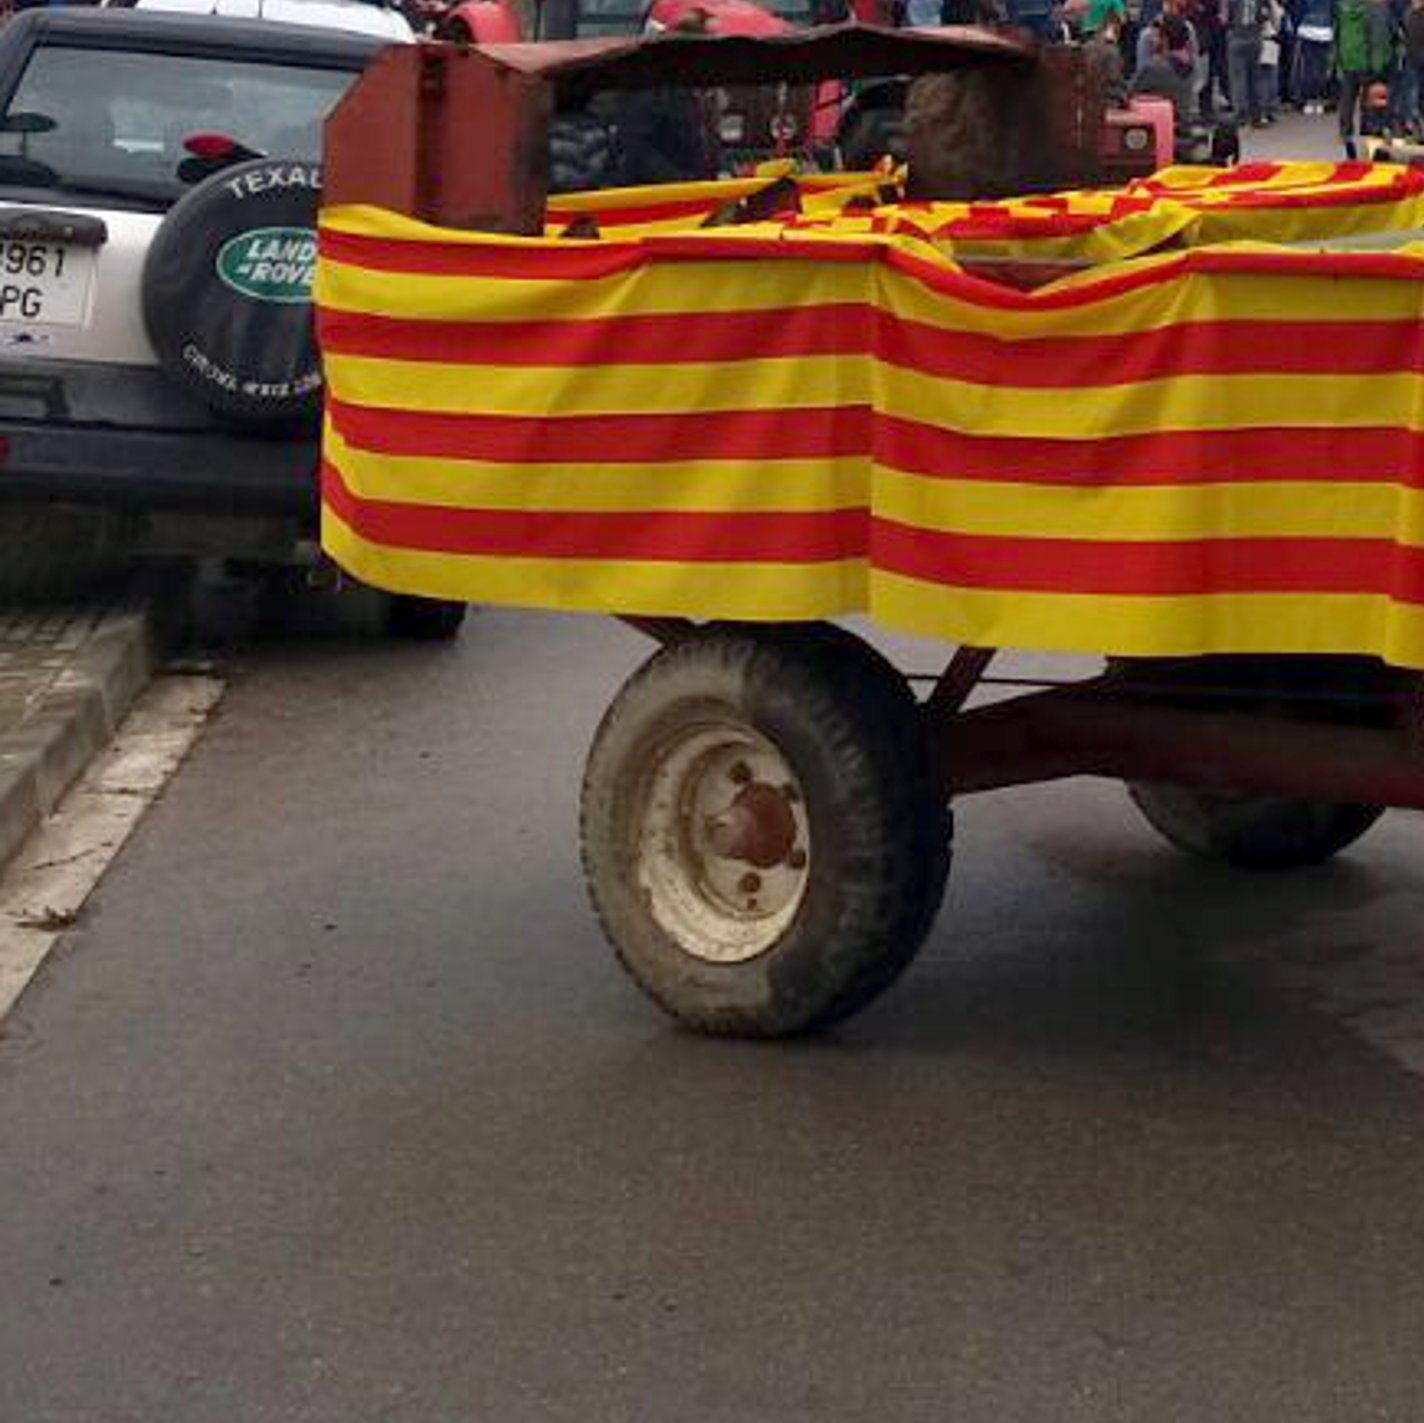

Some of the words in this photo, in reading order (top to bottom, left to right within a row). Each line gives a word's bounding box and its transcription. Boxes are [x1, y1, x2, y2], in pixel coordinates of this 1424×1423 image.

[0, 243, 64, 277] 961
[247, 239, 317, 261] LAND
[250, 261, 317, 284] ROVE
